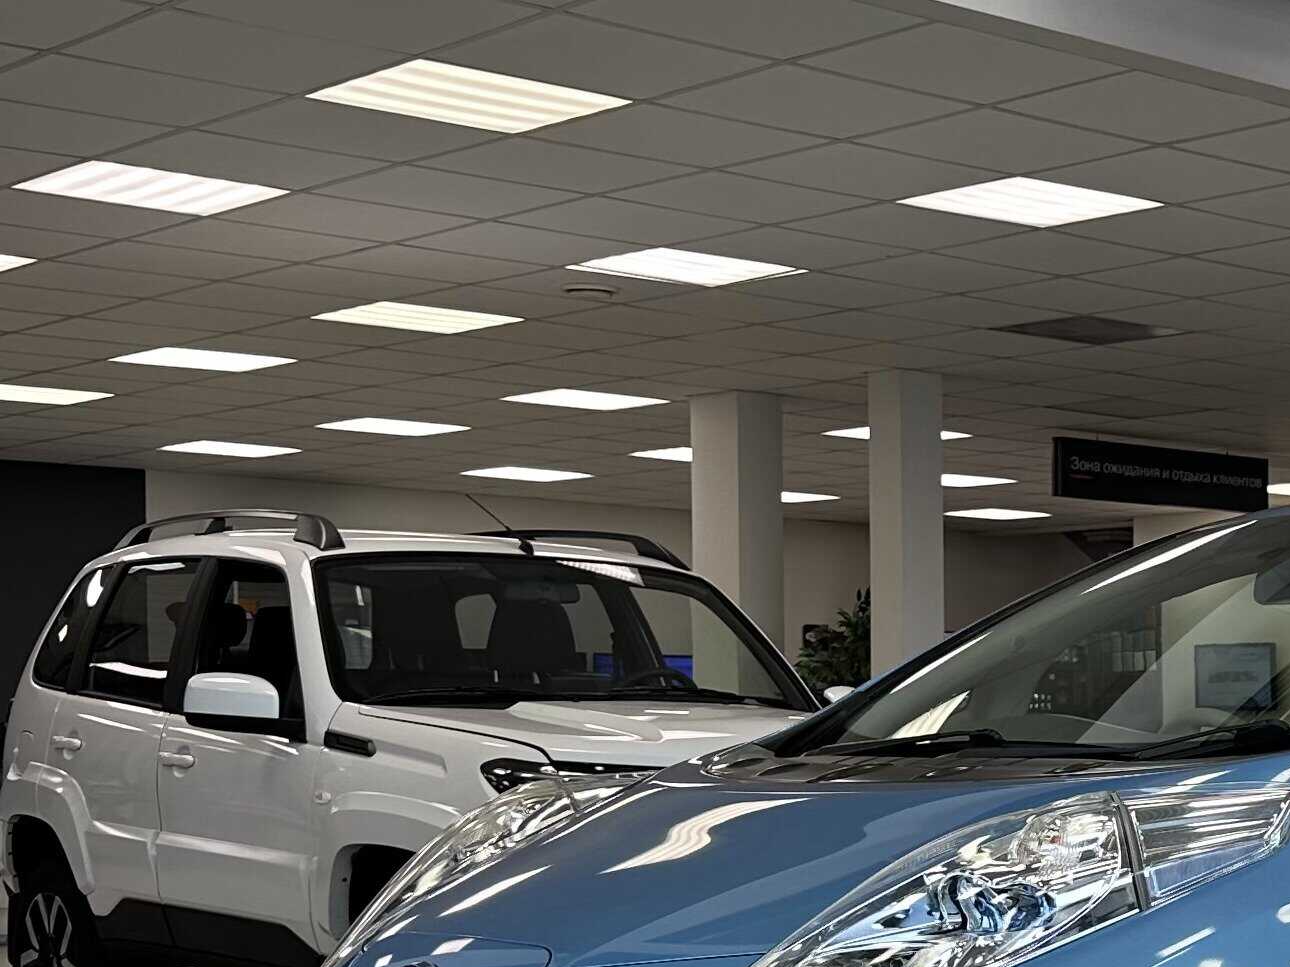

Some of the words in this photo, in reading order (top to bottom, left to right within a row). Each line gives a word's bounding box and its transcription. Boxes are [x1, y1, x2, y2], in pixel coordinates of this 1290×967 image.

[1069, 456, 1101, 473] Зона
[1103, 462, 1160, 478] ожидания
[1162, 468, 1171, 479] и
[1171, 470, 1211, 484] отдыха
[1212, 473, 1263, 489] клиентов
